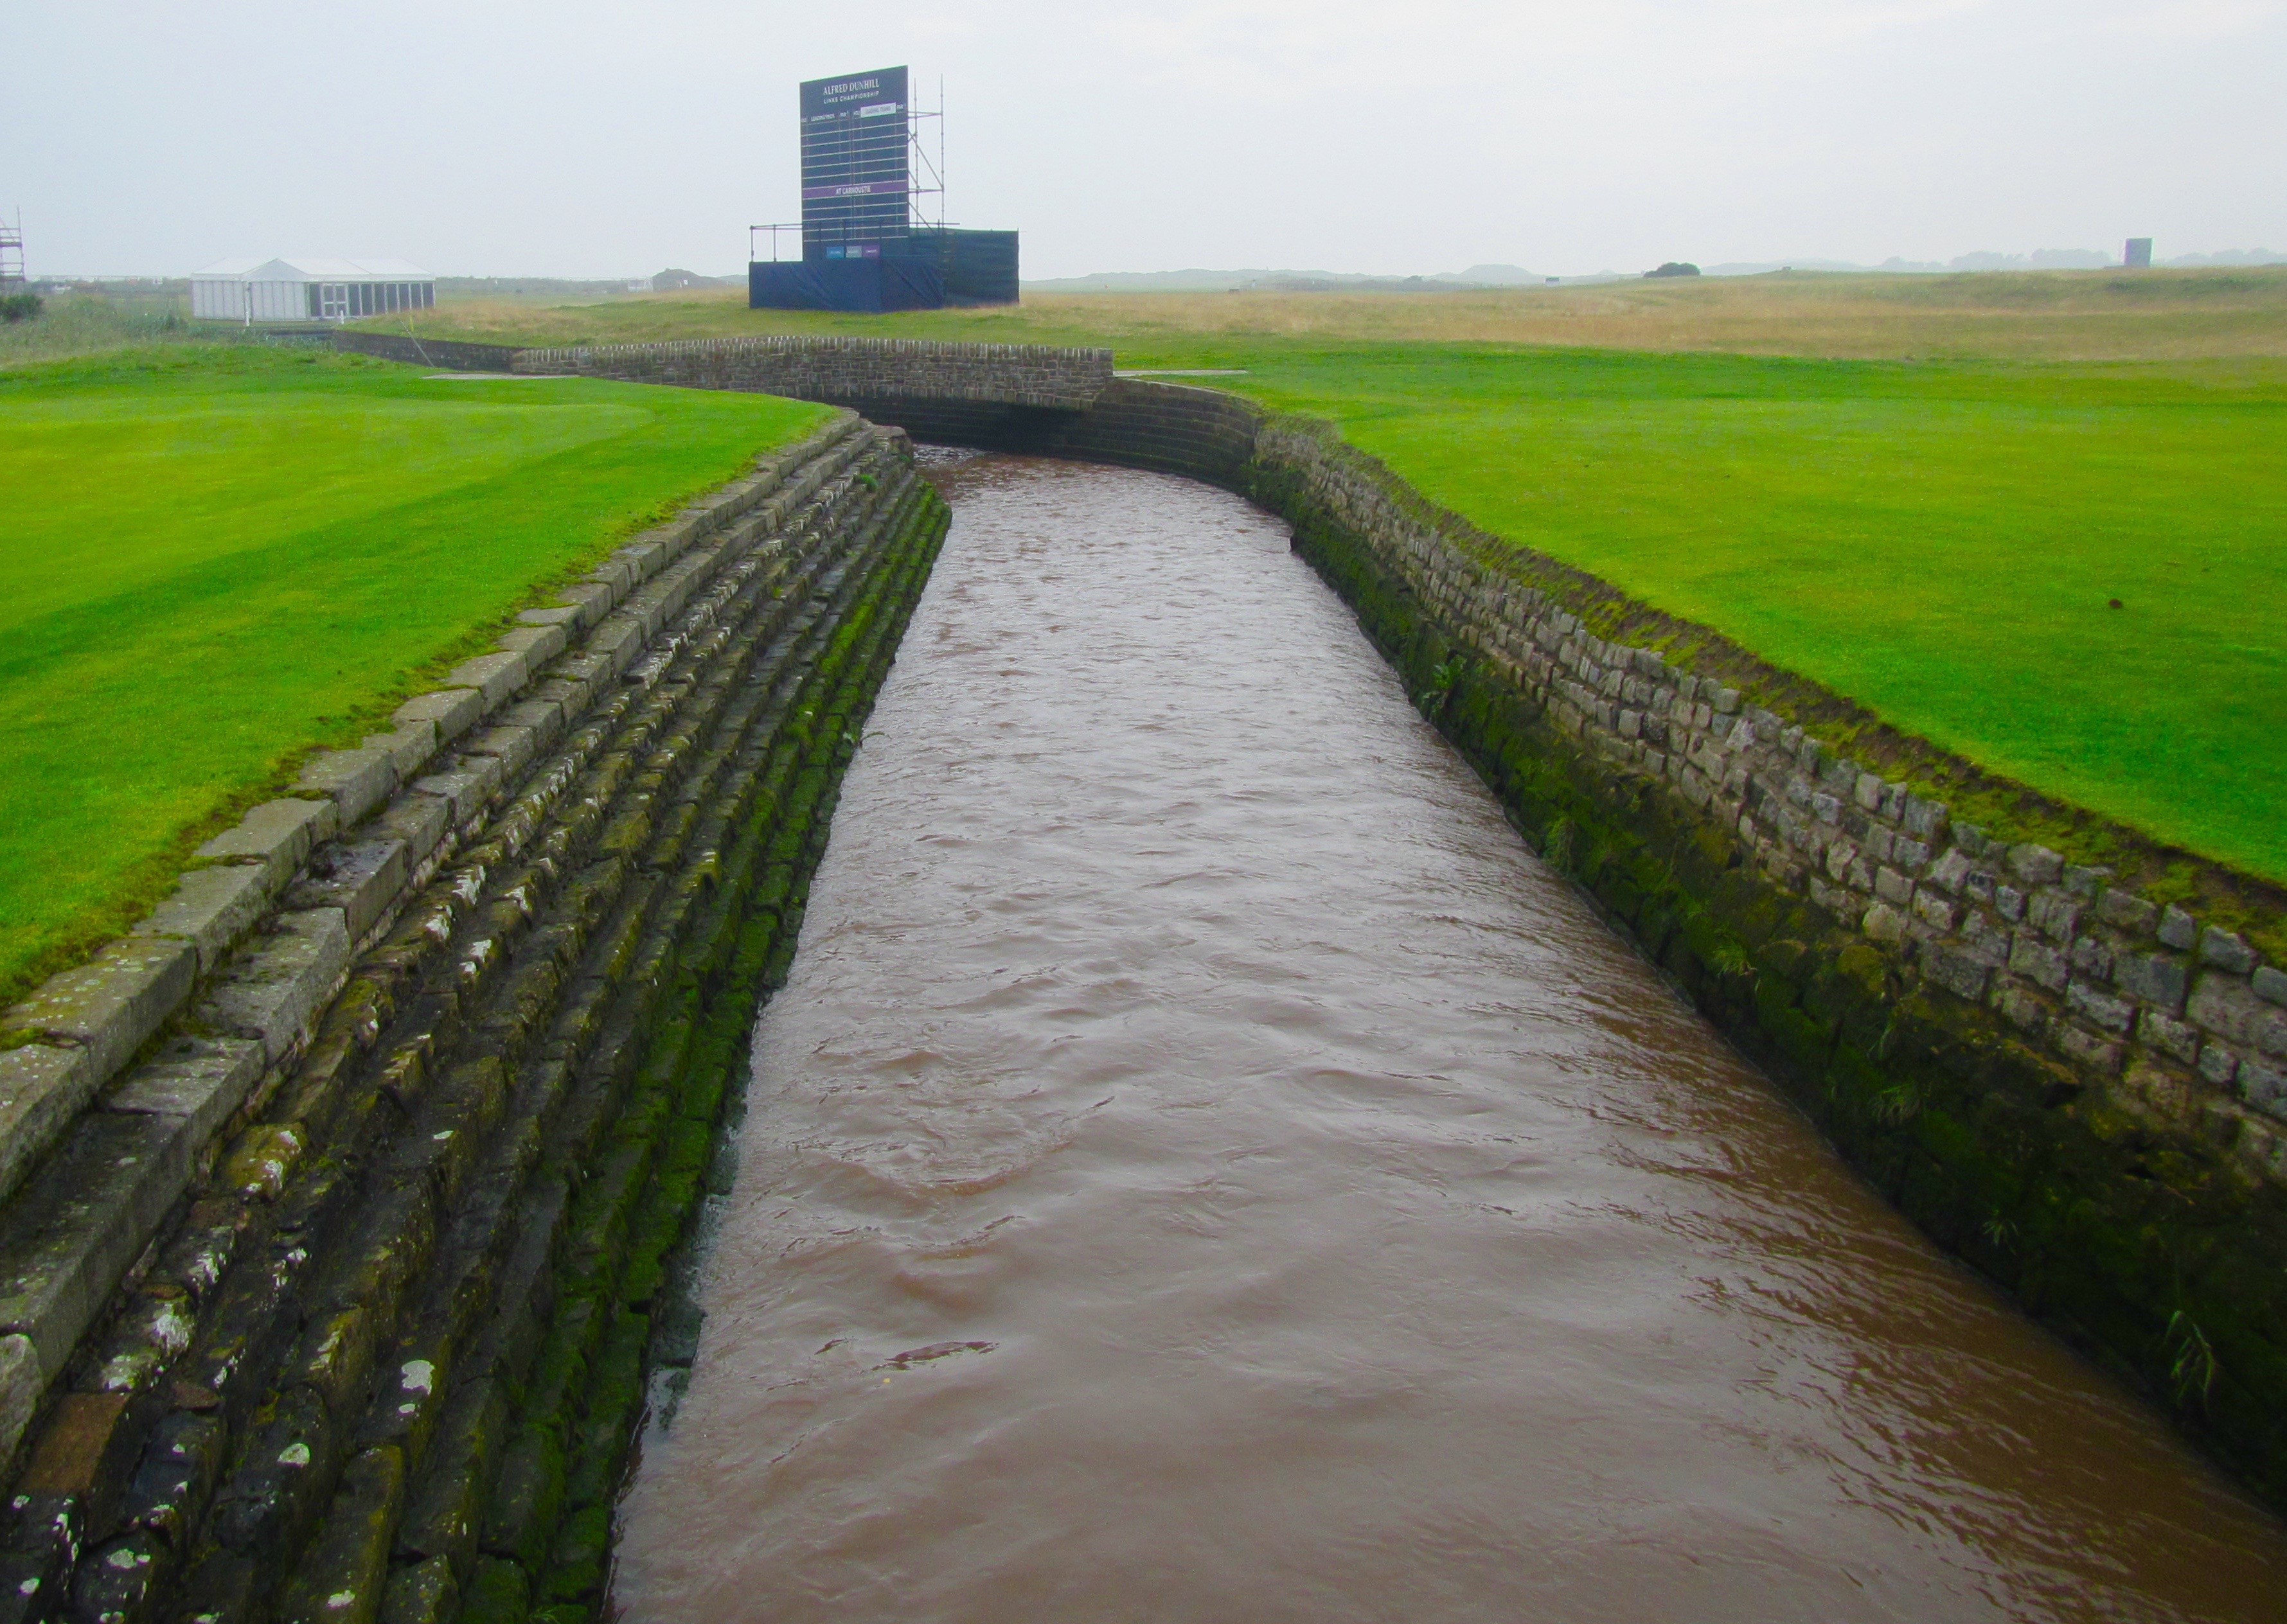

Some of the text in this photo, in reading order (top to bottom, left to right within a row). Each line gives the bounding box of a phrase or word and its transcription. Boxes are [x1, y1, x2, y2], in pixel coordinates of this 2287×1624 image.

[823, 78, 879, 95] ALFRED DUNHILL
[839, 91, 879, 102] CHAMPIONSHIP
